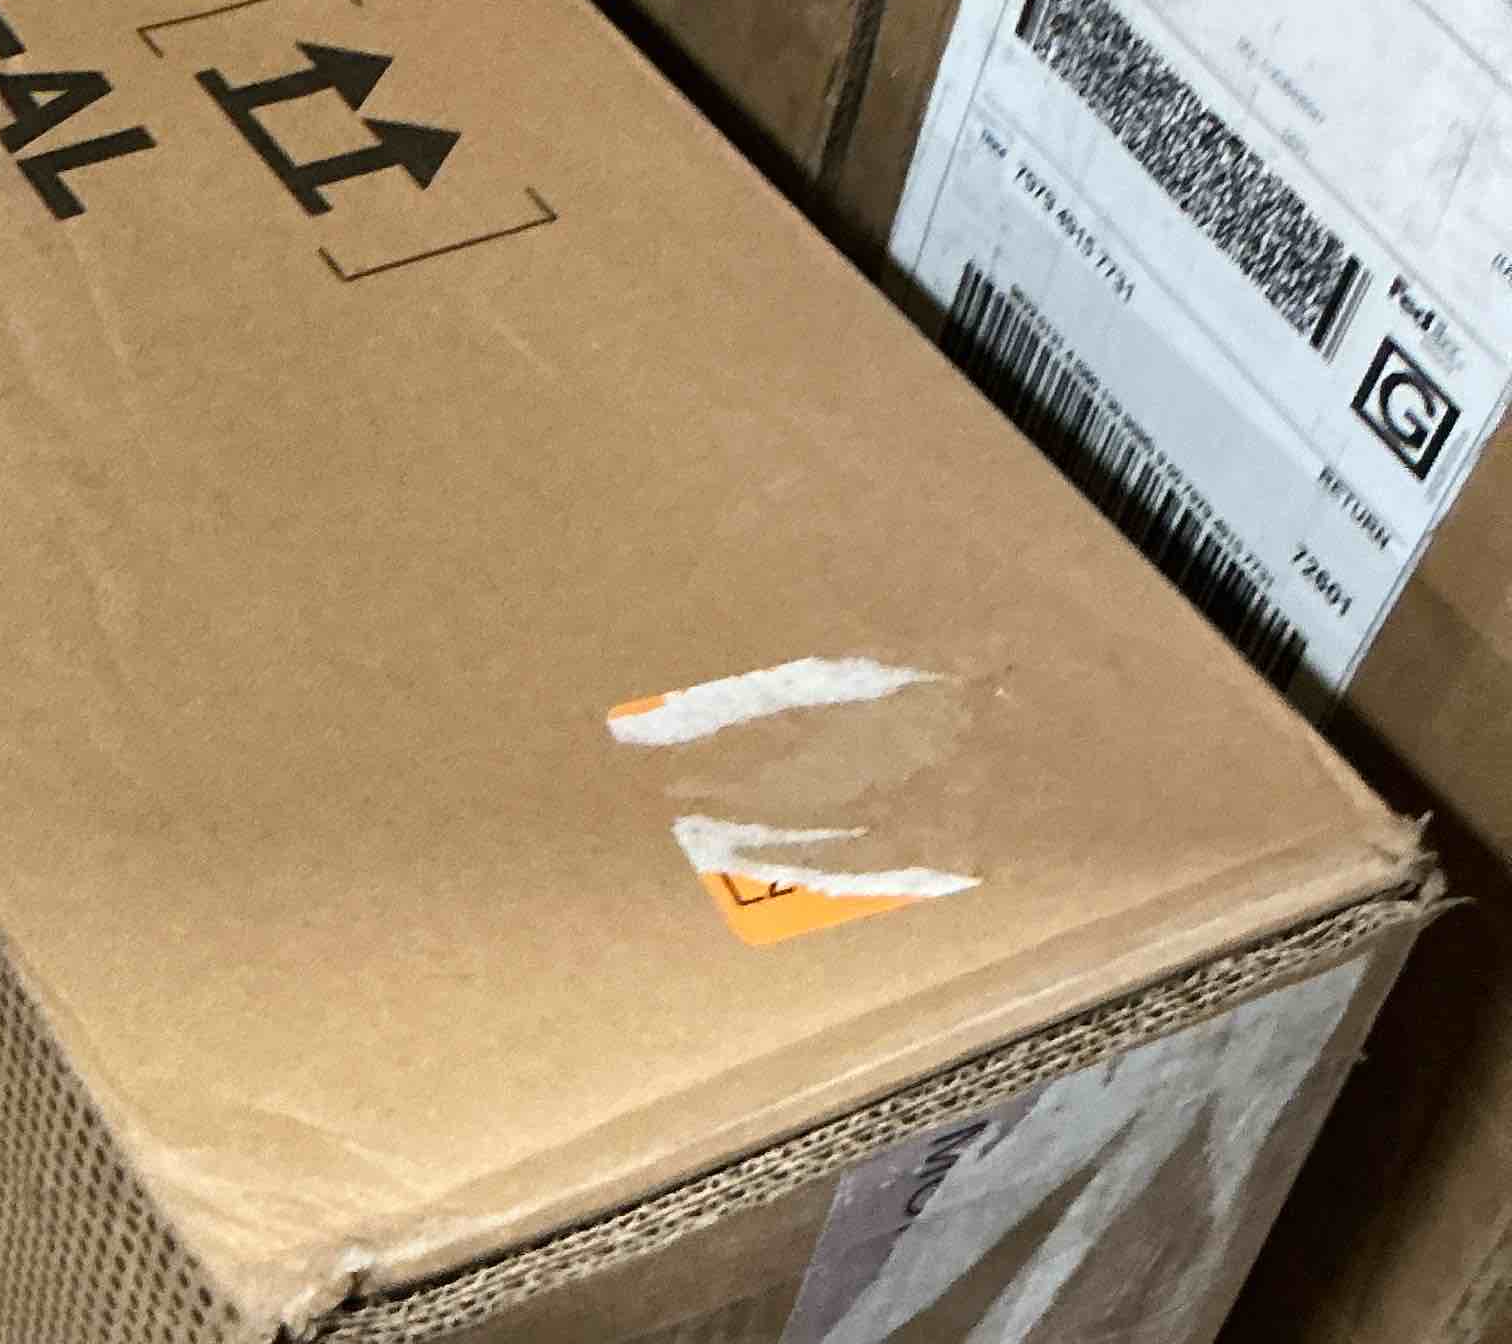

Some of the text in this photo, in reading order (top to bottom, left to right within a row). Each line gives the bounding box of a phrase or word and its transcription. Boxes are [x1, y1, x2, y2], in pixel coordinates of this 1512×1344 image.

[1379, 370, 1436, 449] G
[1318, 465, 1390, 550] RETURN
[1290, 544, 1354, 617] 72601
